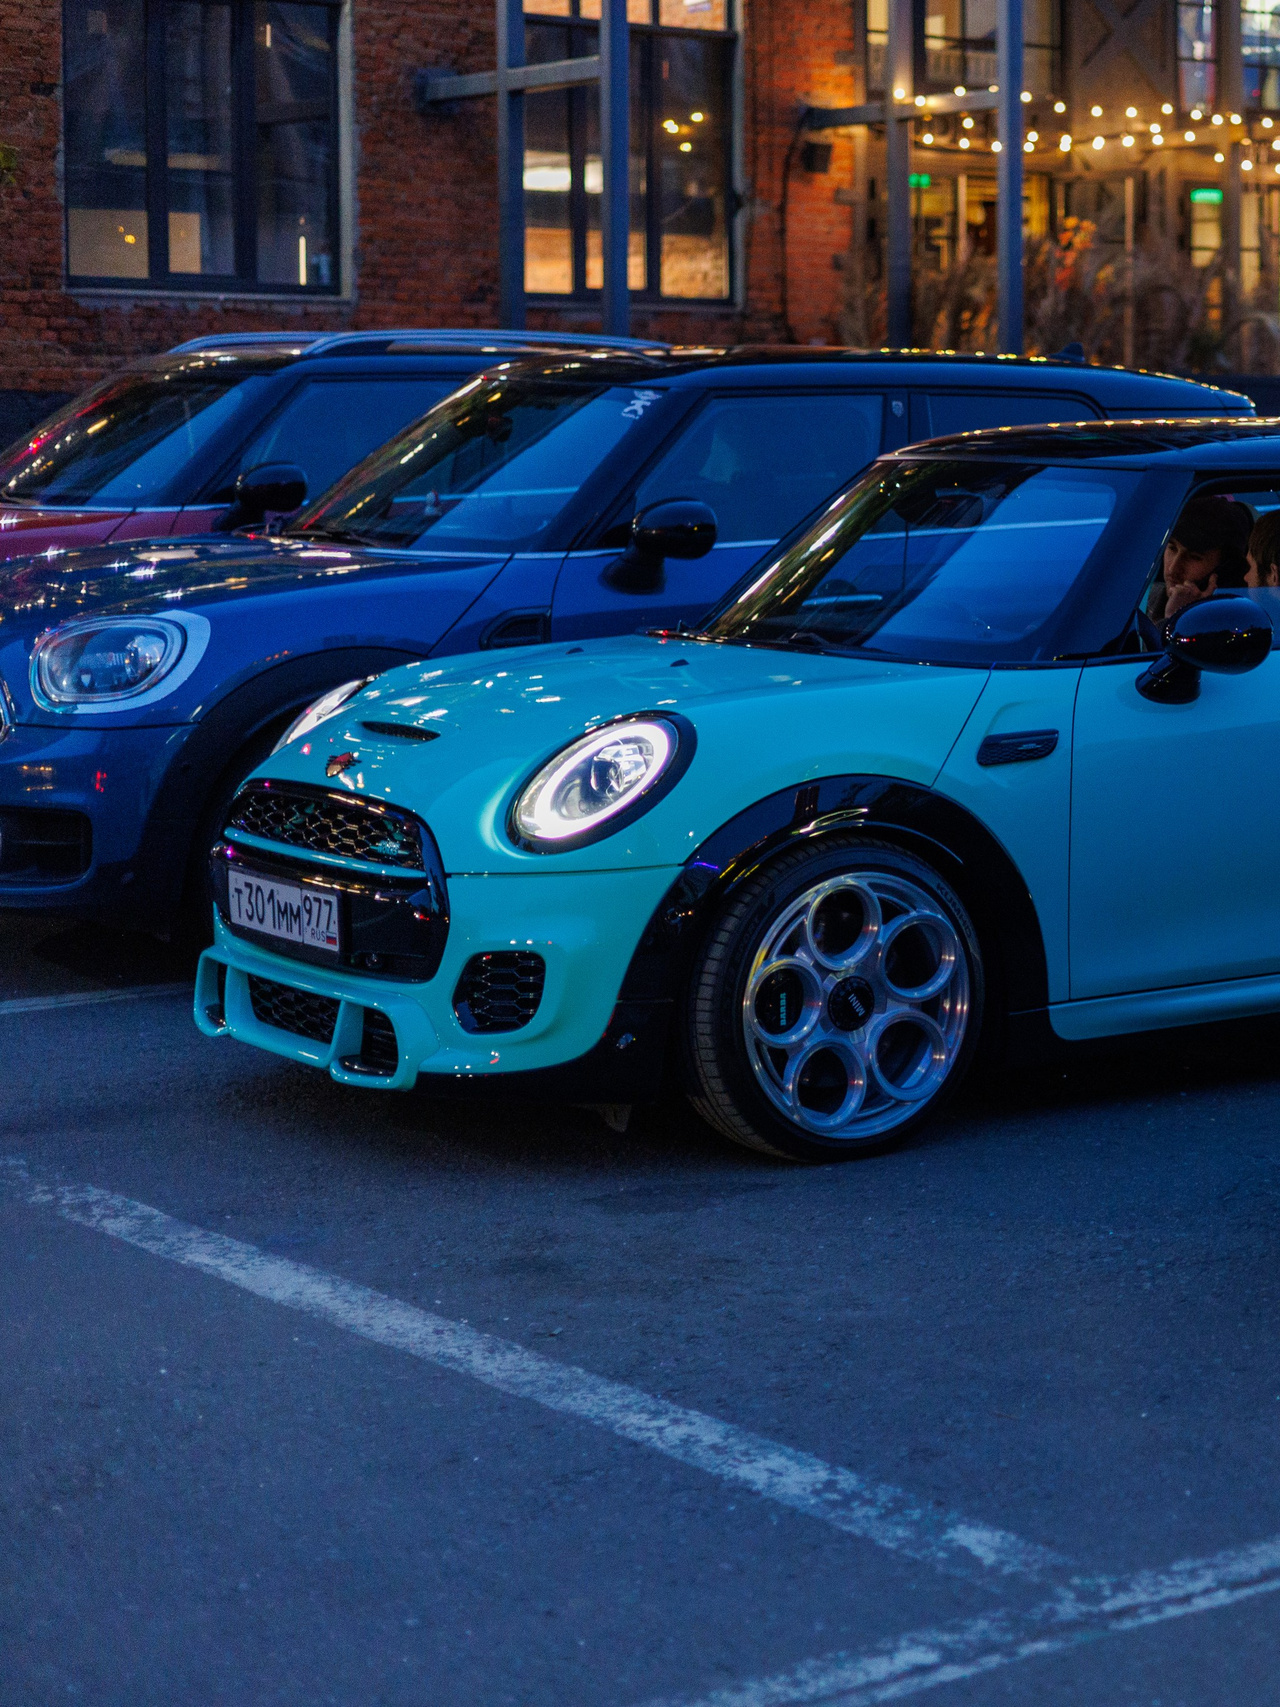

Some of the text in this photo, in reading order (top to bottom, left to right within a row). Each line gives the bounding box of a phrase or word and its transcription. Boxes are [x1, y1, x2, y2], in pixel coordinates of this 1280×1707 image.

[303, 895, 333, 931] 977
[310, 928, 326, 943] RUS
[848, 993, 866, 1018] MINI
